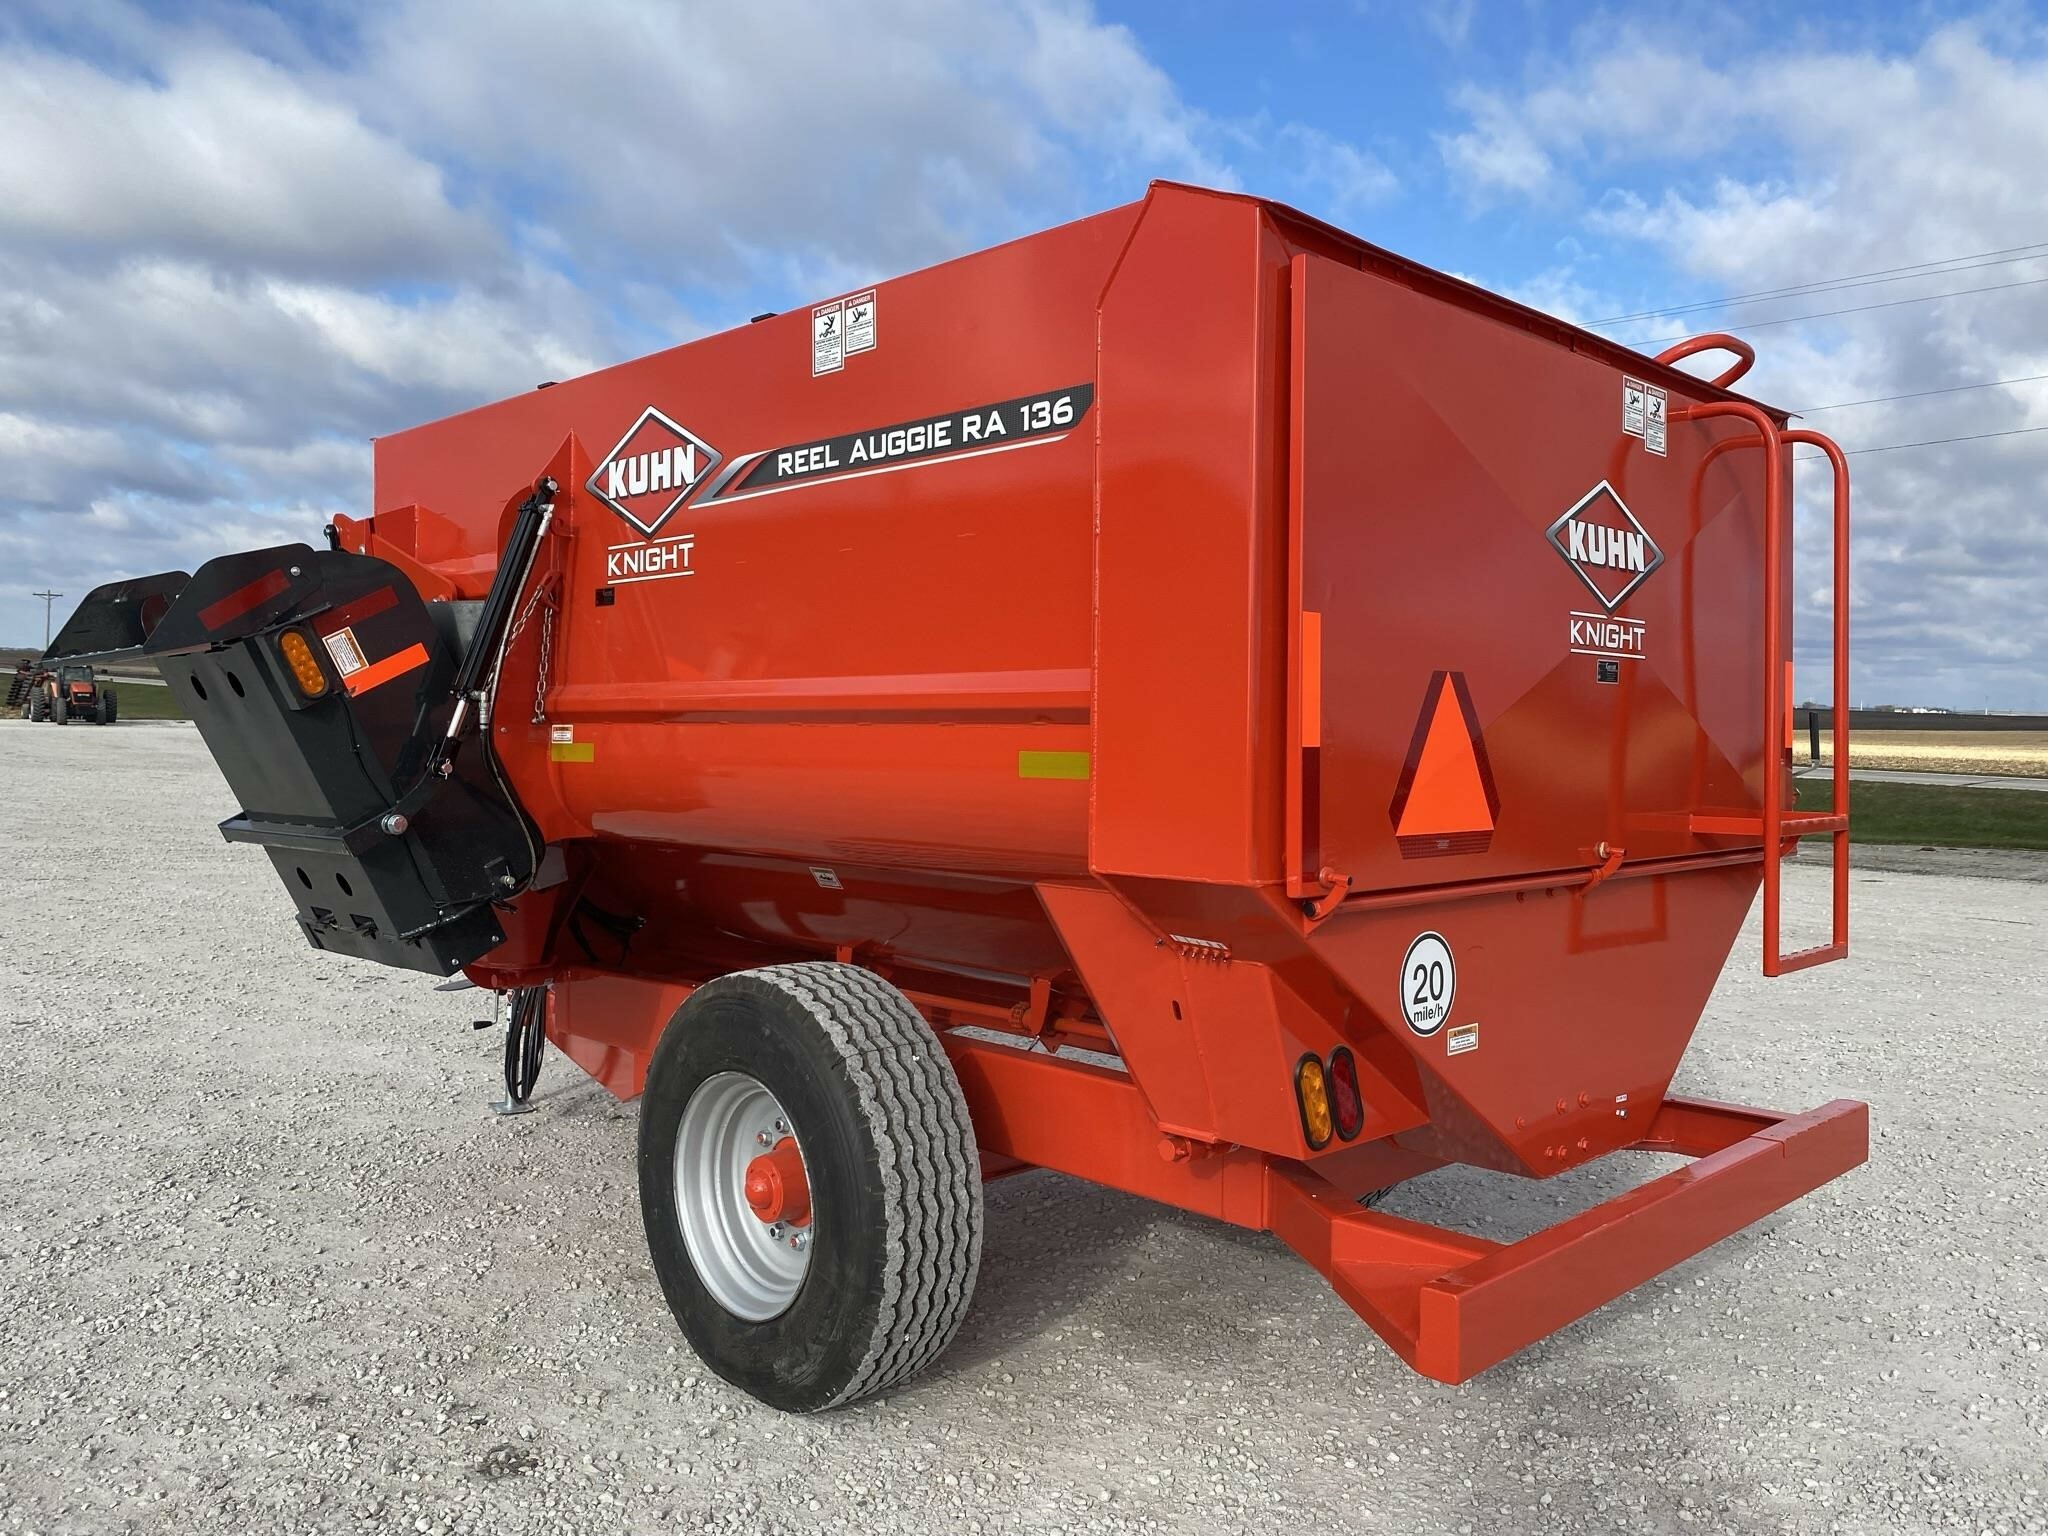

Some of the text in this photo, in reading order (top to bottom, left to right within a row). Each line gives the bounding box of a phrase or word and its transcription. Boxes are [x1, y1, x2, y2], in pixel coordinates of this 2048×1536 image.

[820, 304, 840, 315] DANGER
[852, 295, 871, 305] DANGER
[777, 396, 1074, 477] REEL AUGGIE RA 136
[608, 443, 695, 500] KUHN
[607, 542, 694, 577] KNIGHT
[1568, 518, 1645, 573] KUHN
[1570, 619, 1646, 651] KNIGHT
[1413, 960, 1444, 1005] 20
[1413, 1003, 1444, 1023] mile/h
